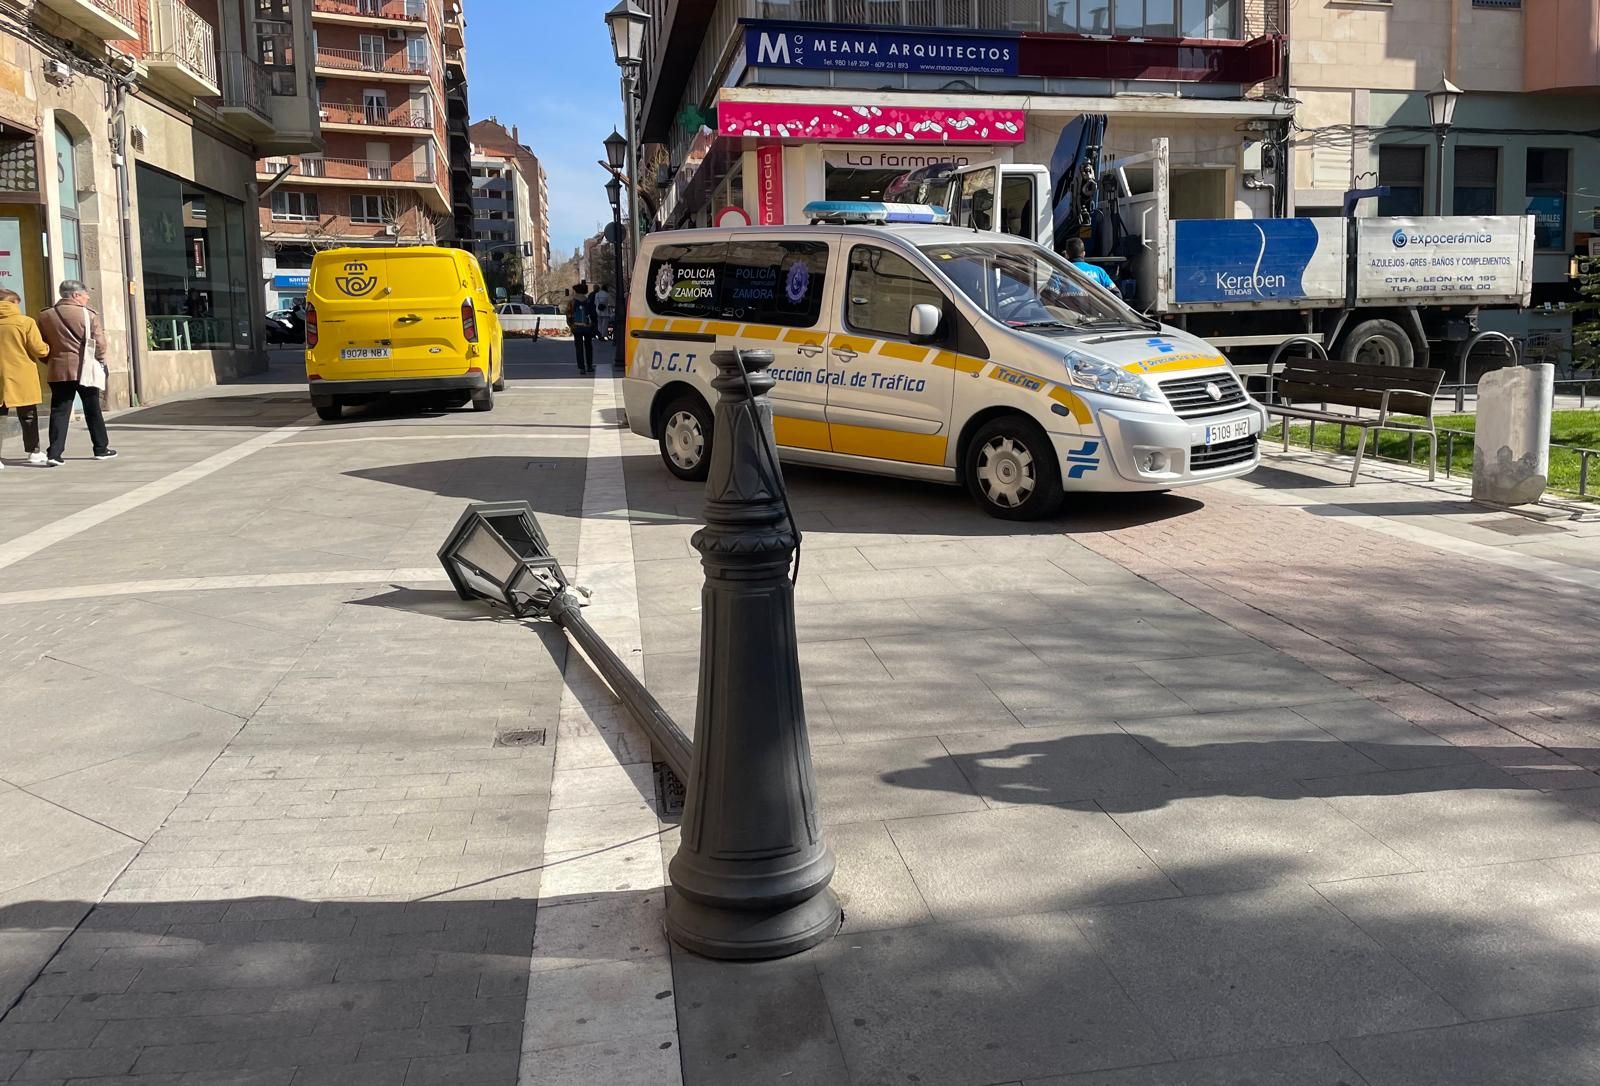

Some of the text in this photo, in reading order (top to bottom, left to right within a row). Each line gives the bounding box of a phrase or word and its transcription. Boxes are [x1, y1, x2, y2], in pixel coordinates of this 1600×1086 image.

[757, 32, 791, 64] M
[795, 34, 804, 65] ARQ
[813, 39, 1011, 62] MEANA ARQUITECTOS
[834, 59, 846, 67] 980
[859, 60, 870, 68] 209
[897, 62, 909, 70] 893
[919, 63, 1005, 73] www.meanaarquitectos.com
[846, 152, 873, 166] La
[764, 153, 773, 226] armacia
[1410, 232, 1492, 247] expocerámica
[1371, 259, 1405, 267] AZULEJOS
[1409, 258, 1427, 266] GRES
[1432, 256, 1454, 266] BAÑOS
[1461, 256, 1511, 266] COMPLEMENTOS
[1216, 272, 1285, 289] Keraben
[674, 287, 713, 298] ZAMORA
[346, 349, 368, 358] 9078
[766, 366, 926, 392] rección Gral. de Tráfico
[1211, 424, 1231, 441] 5109
